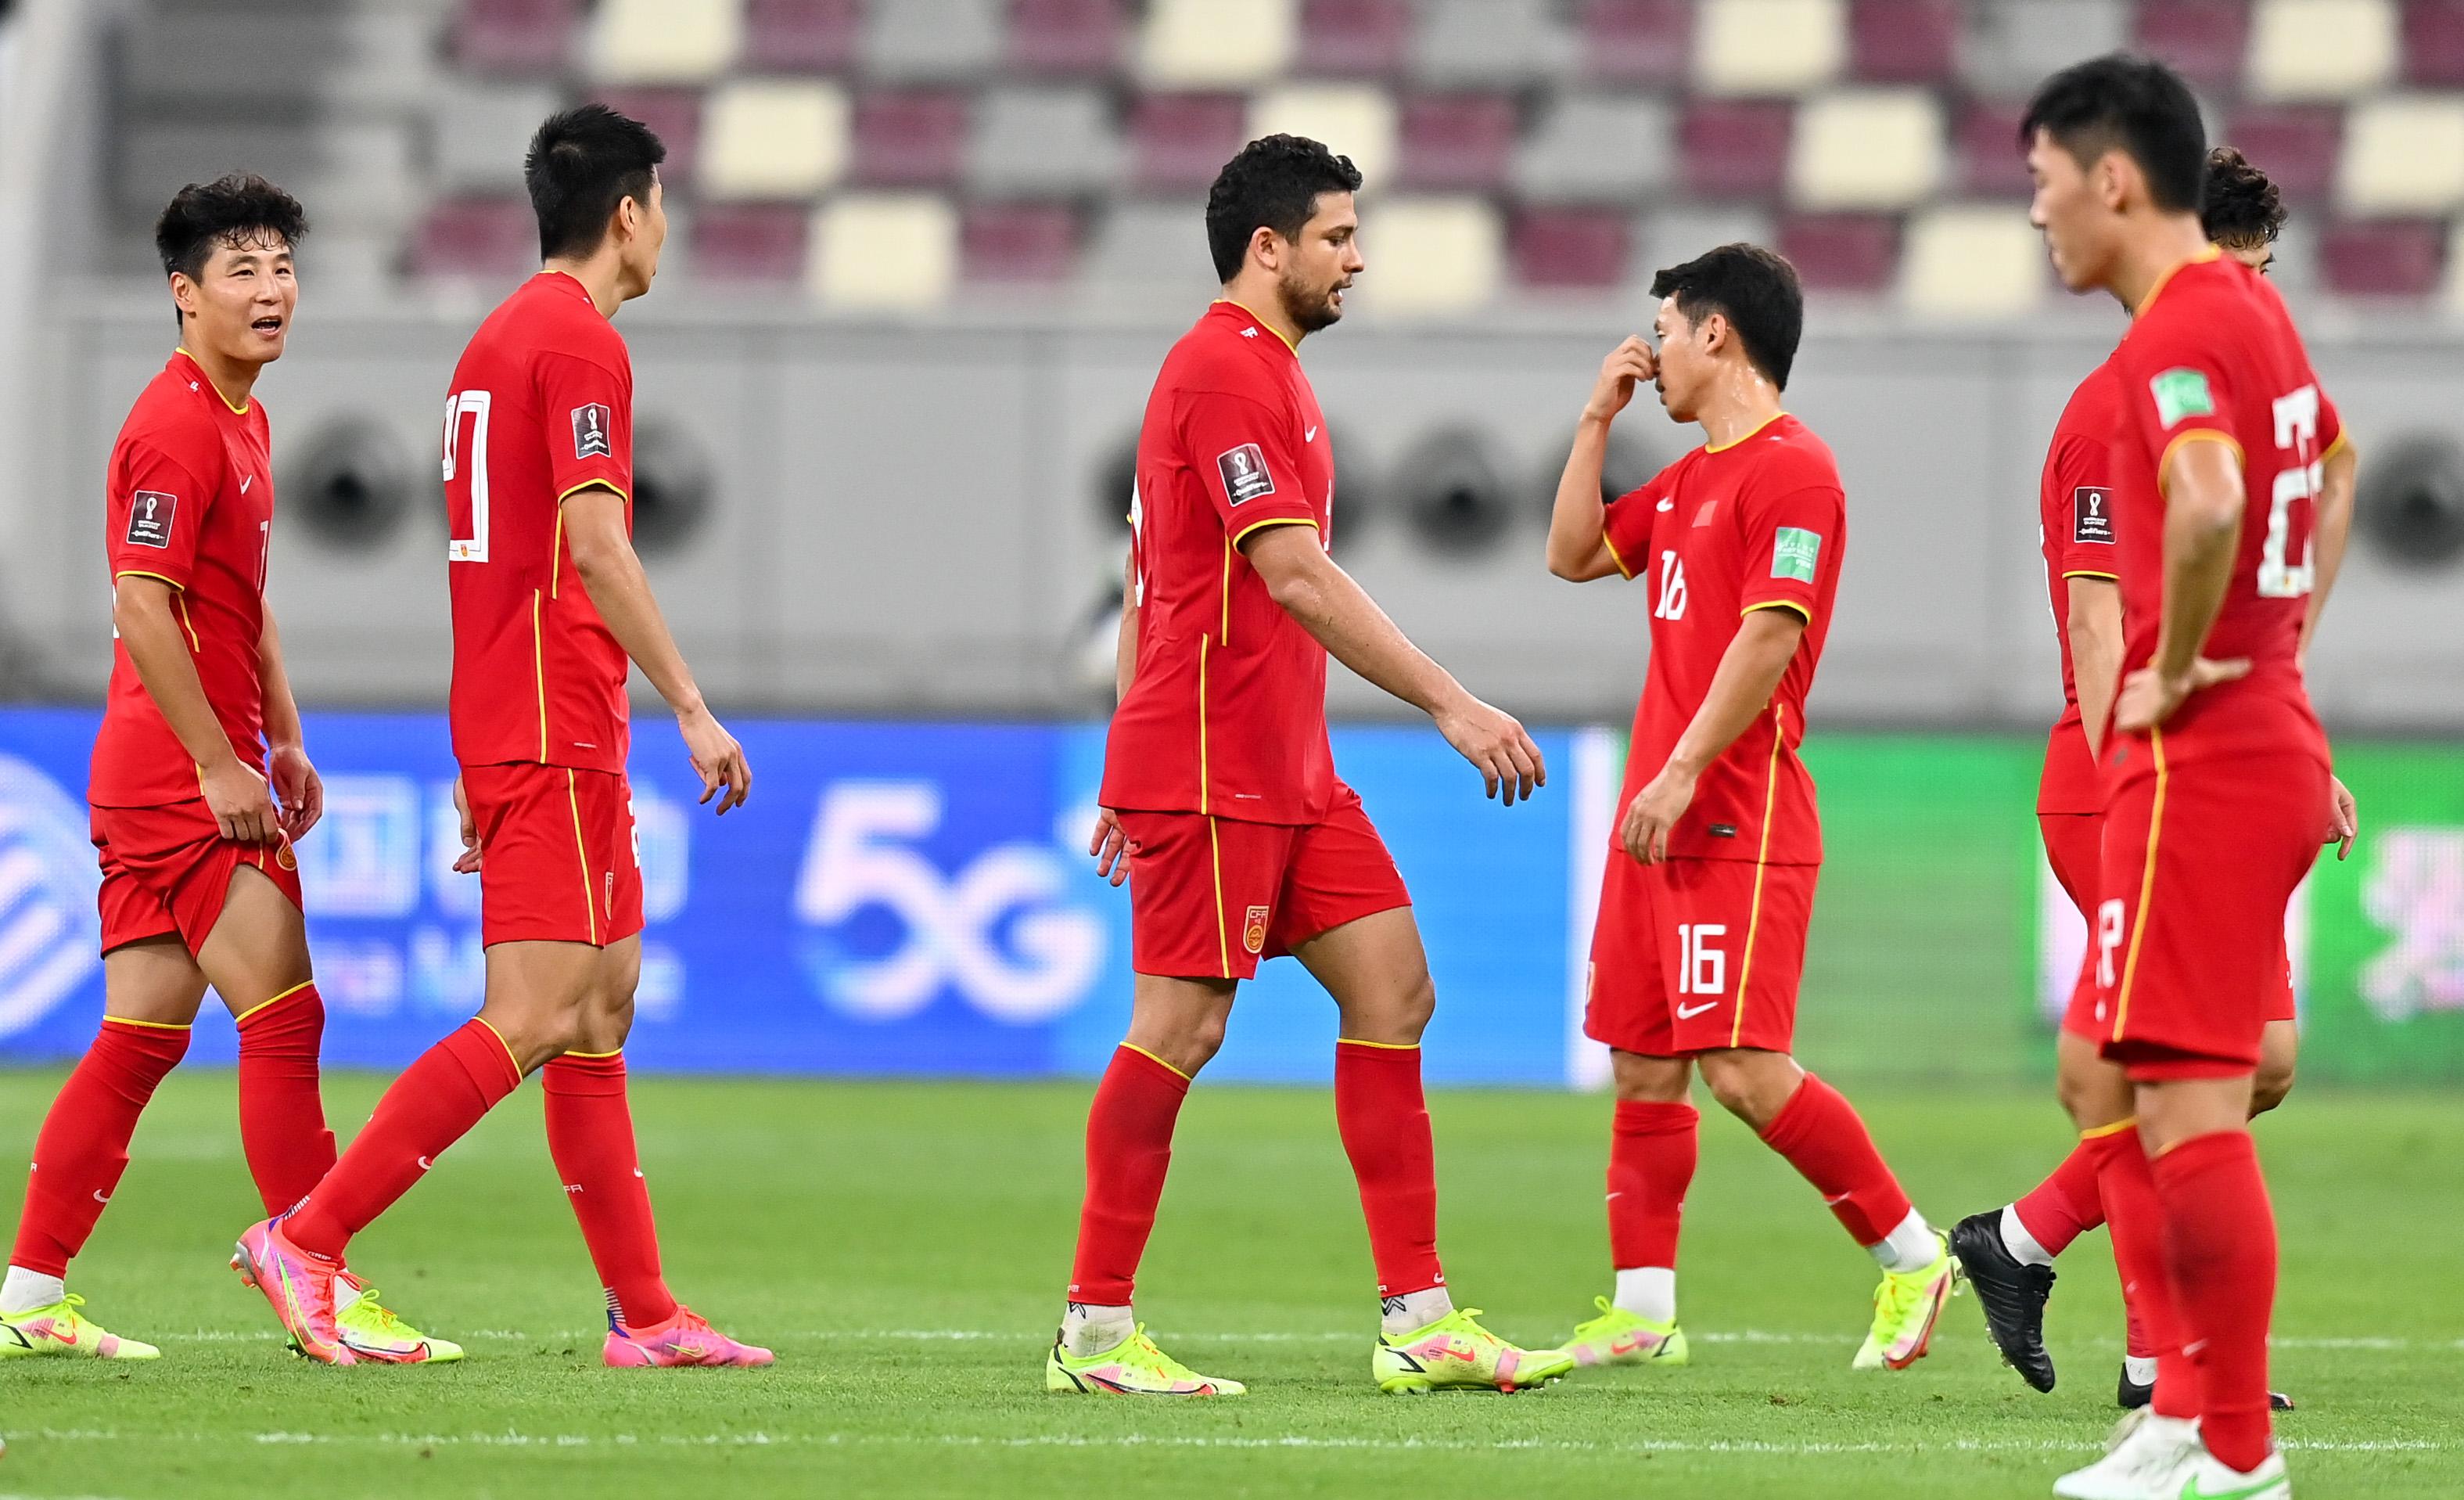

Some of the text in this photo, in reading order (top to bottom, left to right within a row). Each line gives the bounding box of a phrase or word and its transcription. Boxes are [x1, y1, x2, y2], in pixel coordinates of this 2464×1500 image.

[1654, 550, 1688, 621] 16
[796, 781, 1101, 1023] 5G
[1678, 923, 1726, 994] 16
